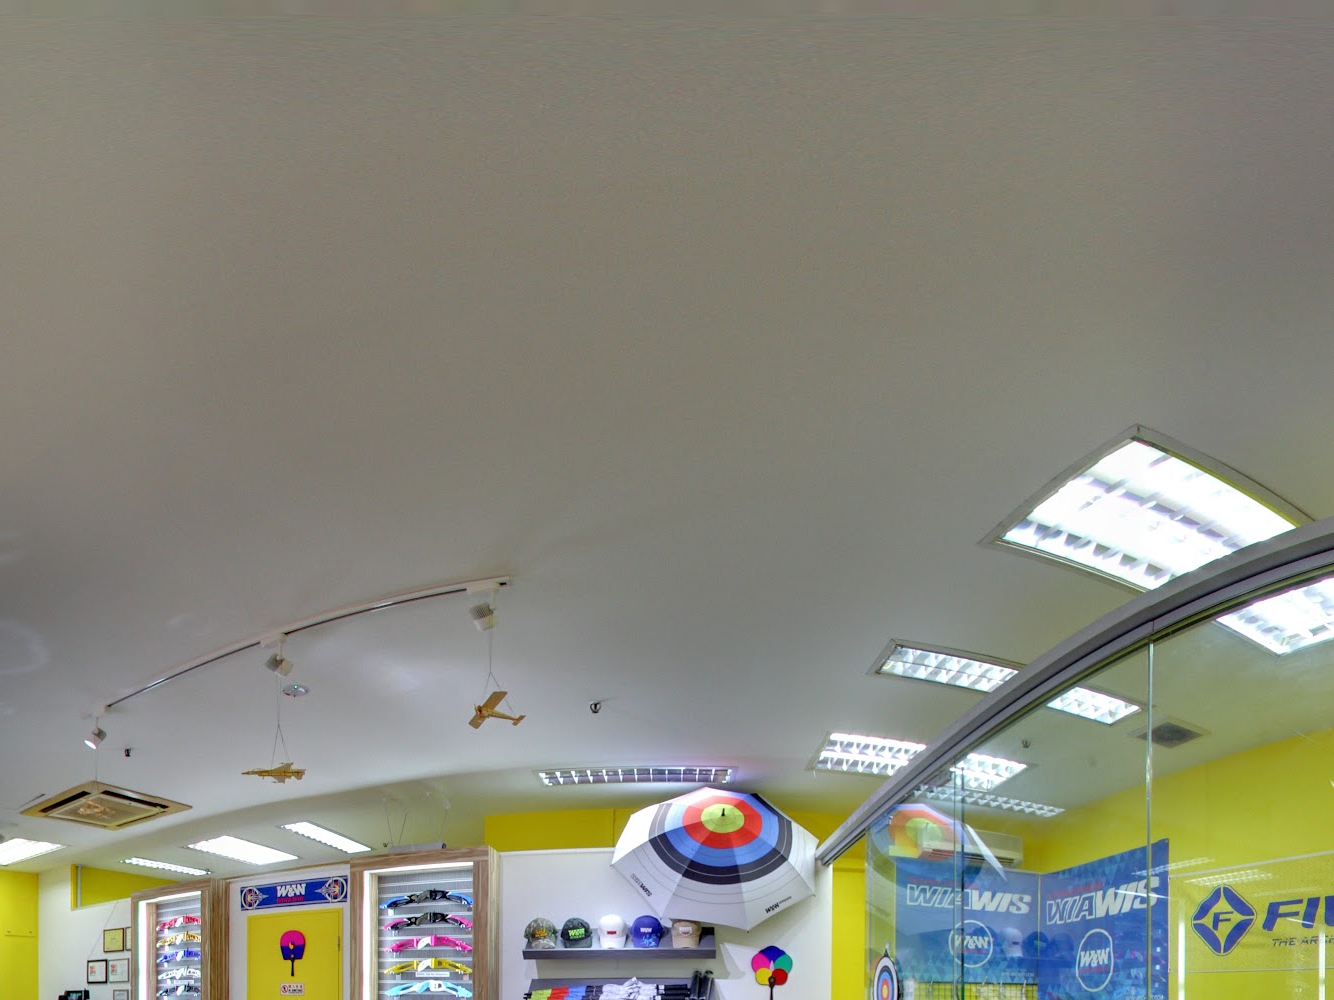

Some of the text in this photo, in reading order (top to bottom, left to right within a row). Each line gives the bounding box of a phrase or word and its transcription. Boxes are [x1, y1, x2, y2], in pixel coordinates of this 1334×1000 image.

[277, 884, 306, 897] W&W
[907, 884, 1031, 914] WIAWIS
[1047, 876, 1159, 925] WIAWIS
[955, 935, 989, 949] W&W
[1272, 937, 1296, 947] THE
[1080, 948, 1110, 967] W&W
